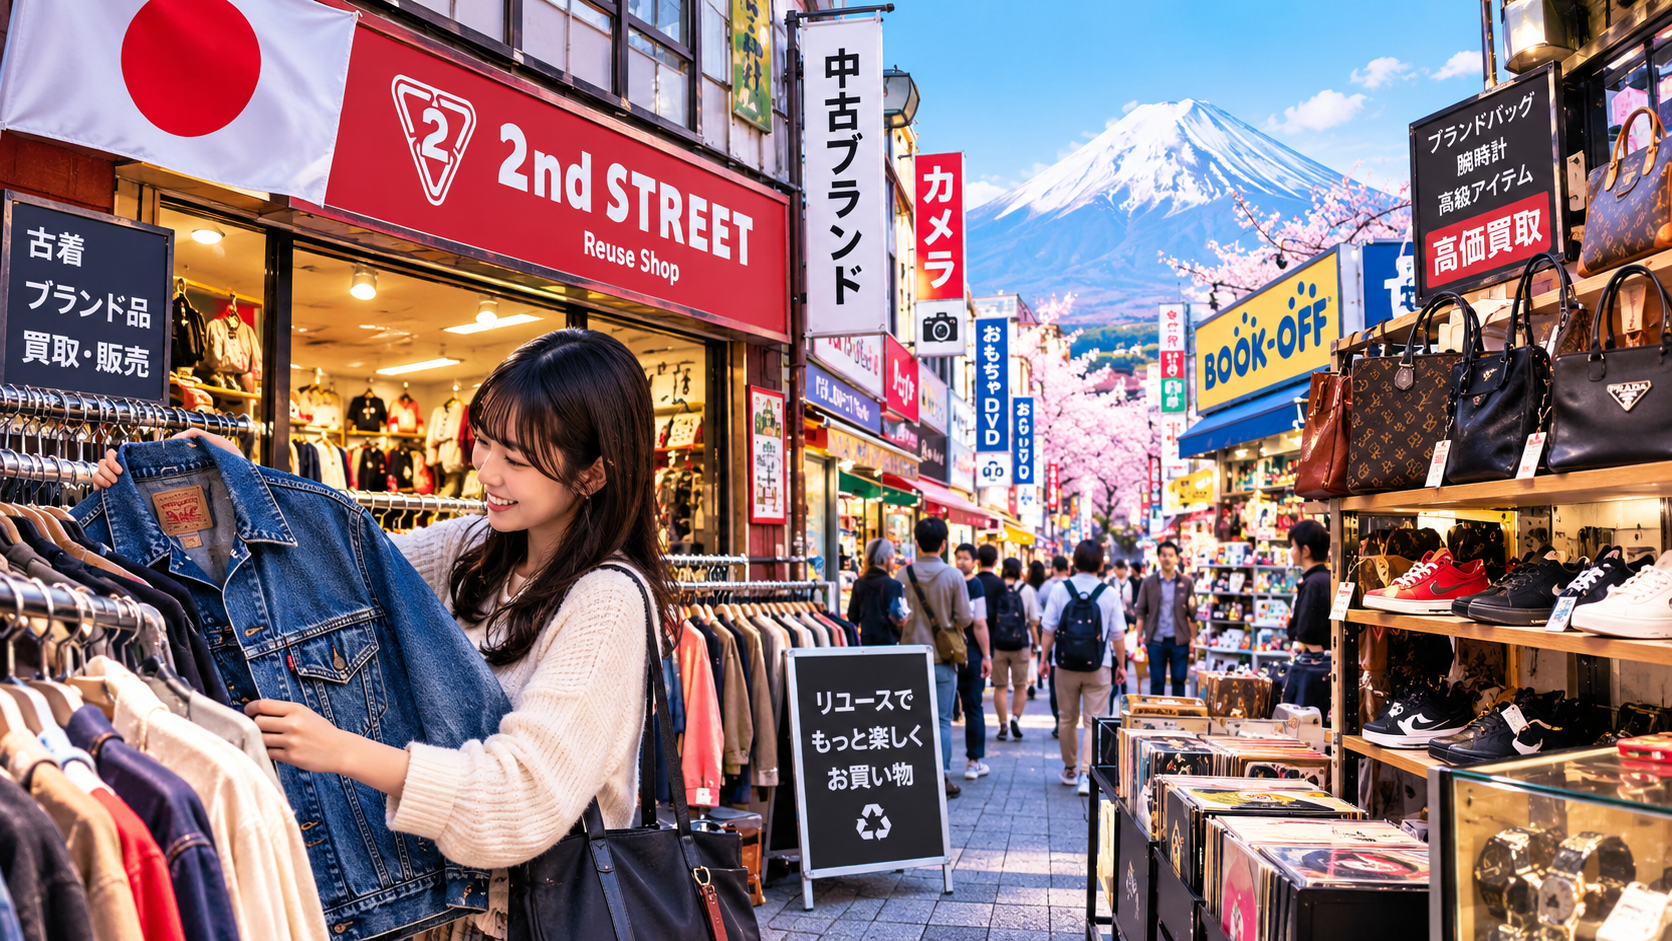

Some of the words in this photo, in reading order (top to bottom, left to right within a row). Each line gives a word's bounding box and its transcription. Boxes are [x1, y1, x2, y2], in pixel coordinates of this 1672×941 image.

[422, 107, 448, 164] 2
[1428, 91, 1535, 153] ブランドバッグ
[825, 48, 862, 304] 中古ブランド
[1457, 137, 1507, 177] 腕時計
[498, 123, 592, 213] 2nd
[606, 163, 754, 267] STREET
[1437, 163, 1534, 216] 高級アイテム
[27, 227, 85, 267] 古着
[923, 166, 955, 289] カメラ
[1433, 208, 1543, 276] 高価買取
[584, 230, 635, 269] Reuse
[641, 249, 680, 285] Shop
[24, 279, 151, 329] ブランド品
[22, 330, 150, 378] 買取・販売
[1205, 297, 1327, 391] BOOK-OFF
[983, 326, 1002, 446] おもちゃDVD
[816, 689, 914, 715] リユースで
[811, 725, 923, 754] もっと楽しく
[827, 762, 914, 791] お買い物
